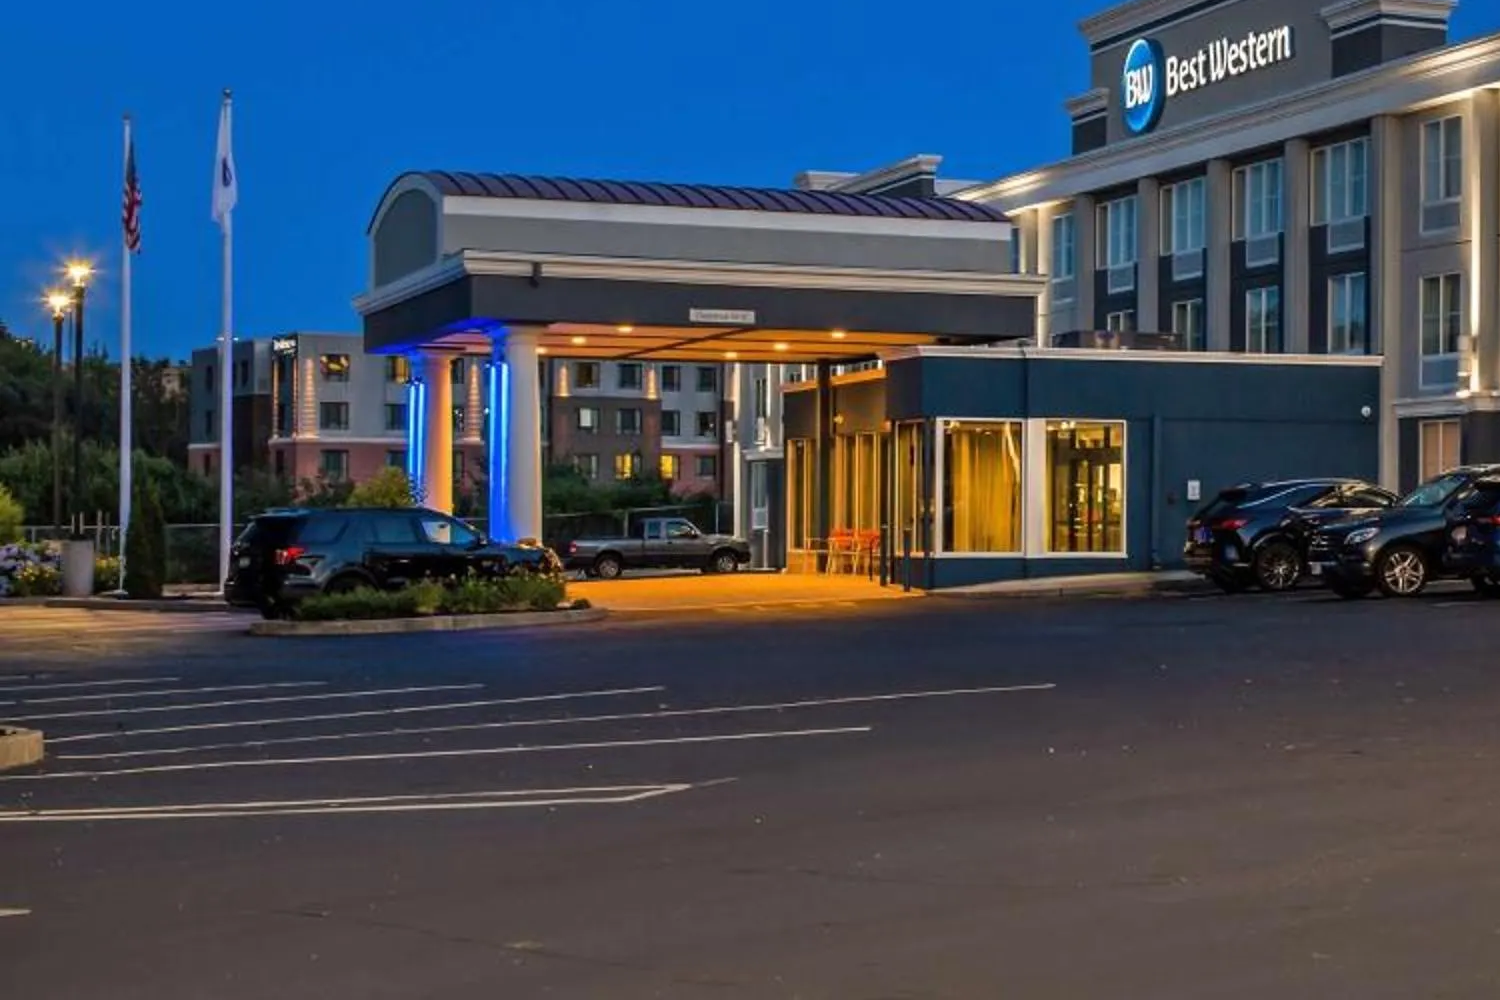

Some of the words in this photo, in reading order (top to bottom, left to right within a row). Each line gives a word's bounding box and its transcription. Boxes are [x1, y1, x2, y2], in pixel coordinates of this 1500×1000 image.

[1125, 64, 1153, 108] BW
[1166, 50, 1208, 97] Best
[1209, 25, 1291, 82] Western
